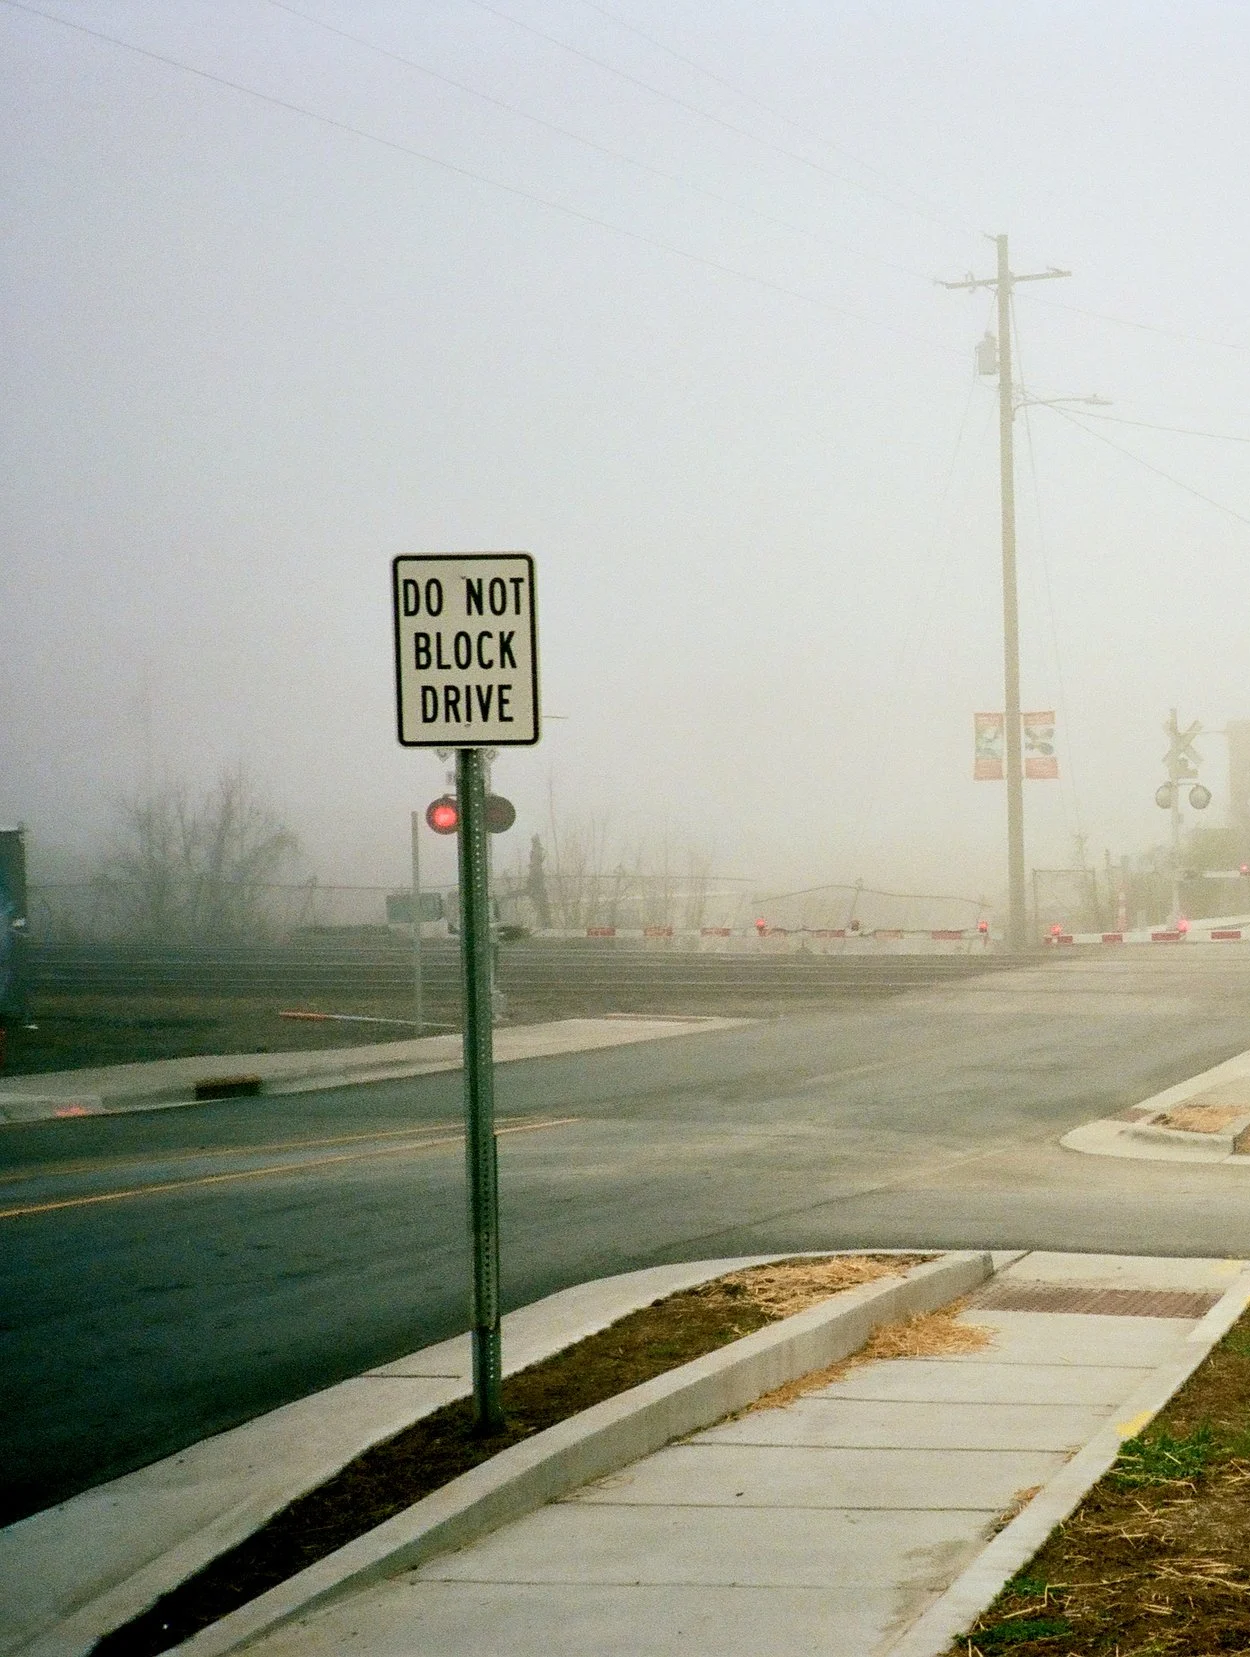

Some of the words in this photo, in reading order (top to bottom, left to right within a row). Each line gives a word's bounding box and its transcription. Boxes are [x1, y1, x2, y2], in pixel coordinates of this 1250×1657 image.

[402, 577, 443, 617] DO
[465, 577, 524, 616] NOT
[414, 630, 517, 670] BLOCK
[421, 684, 514, 723] DRIVE
